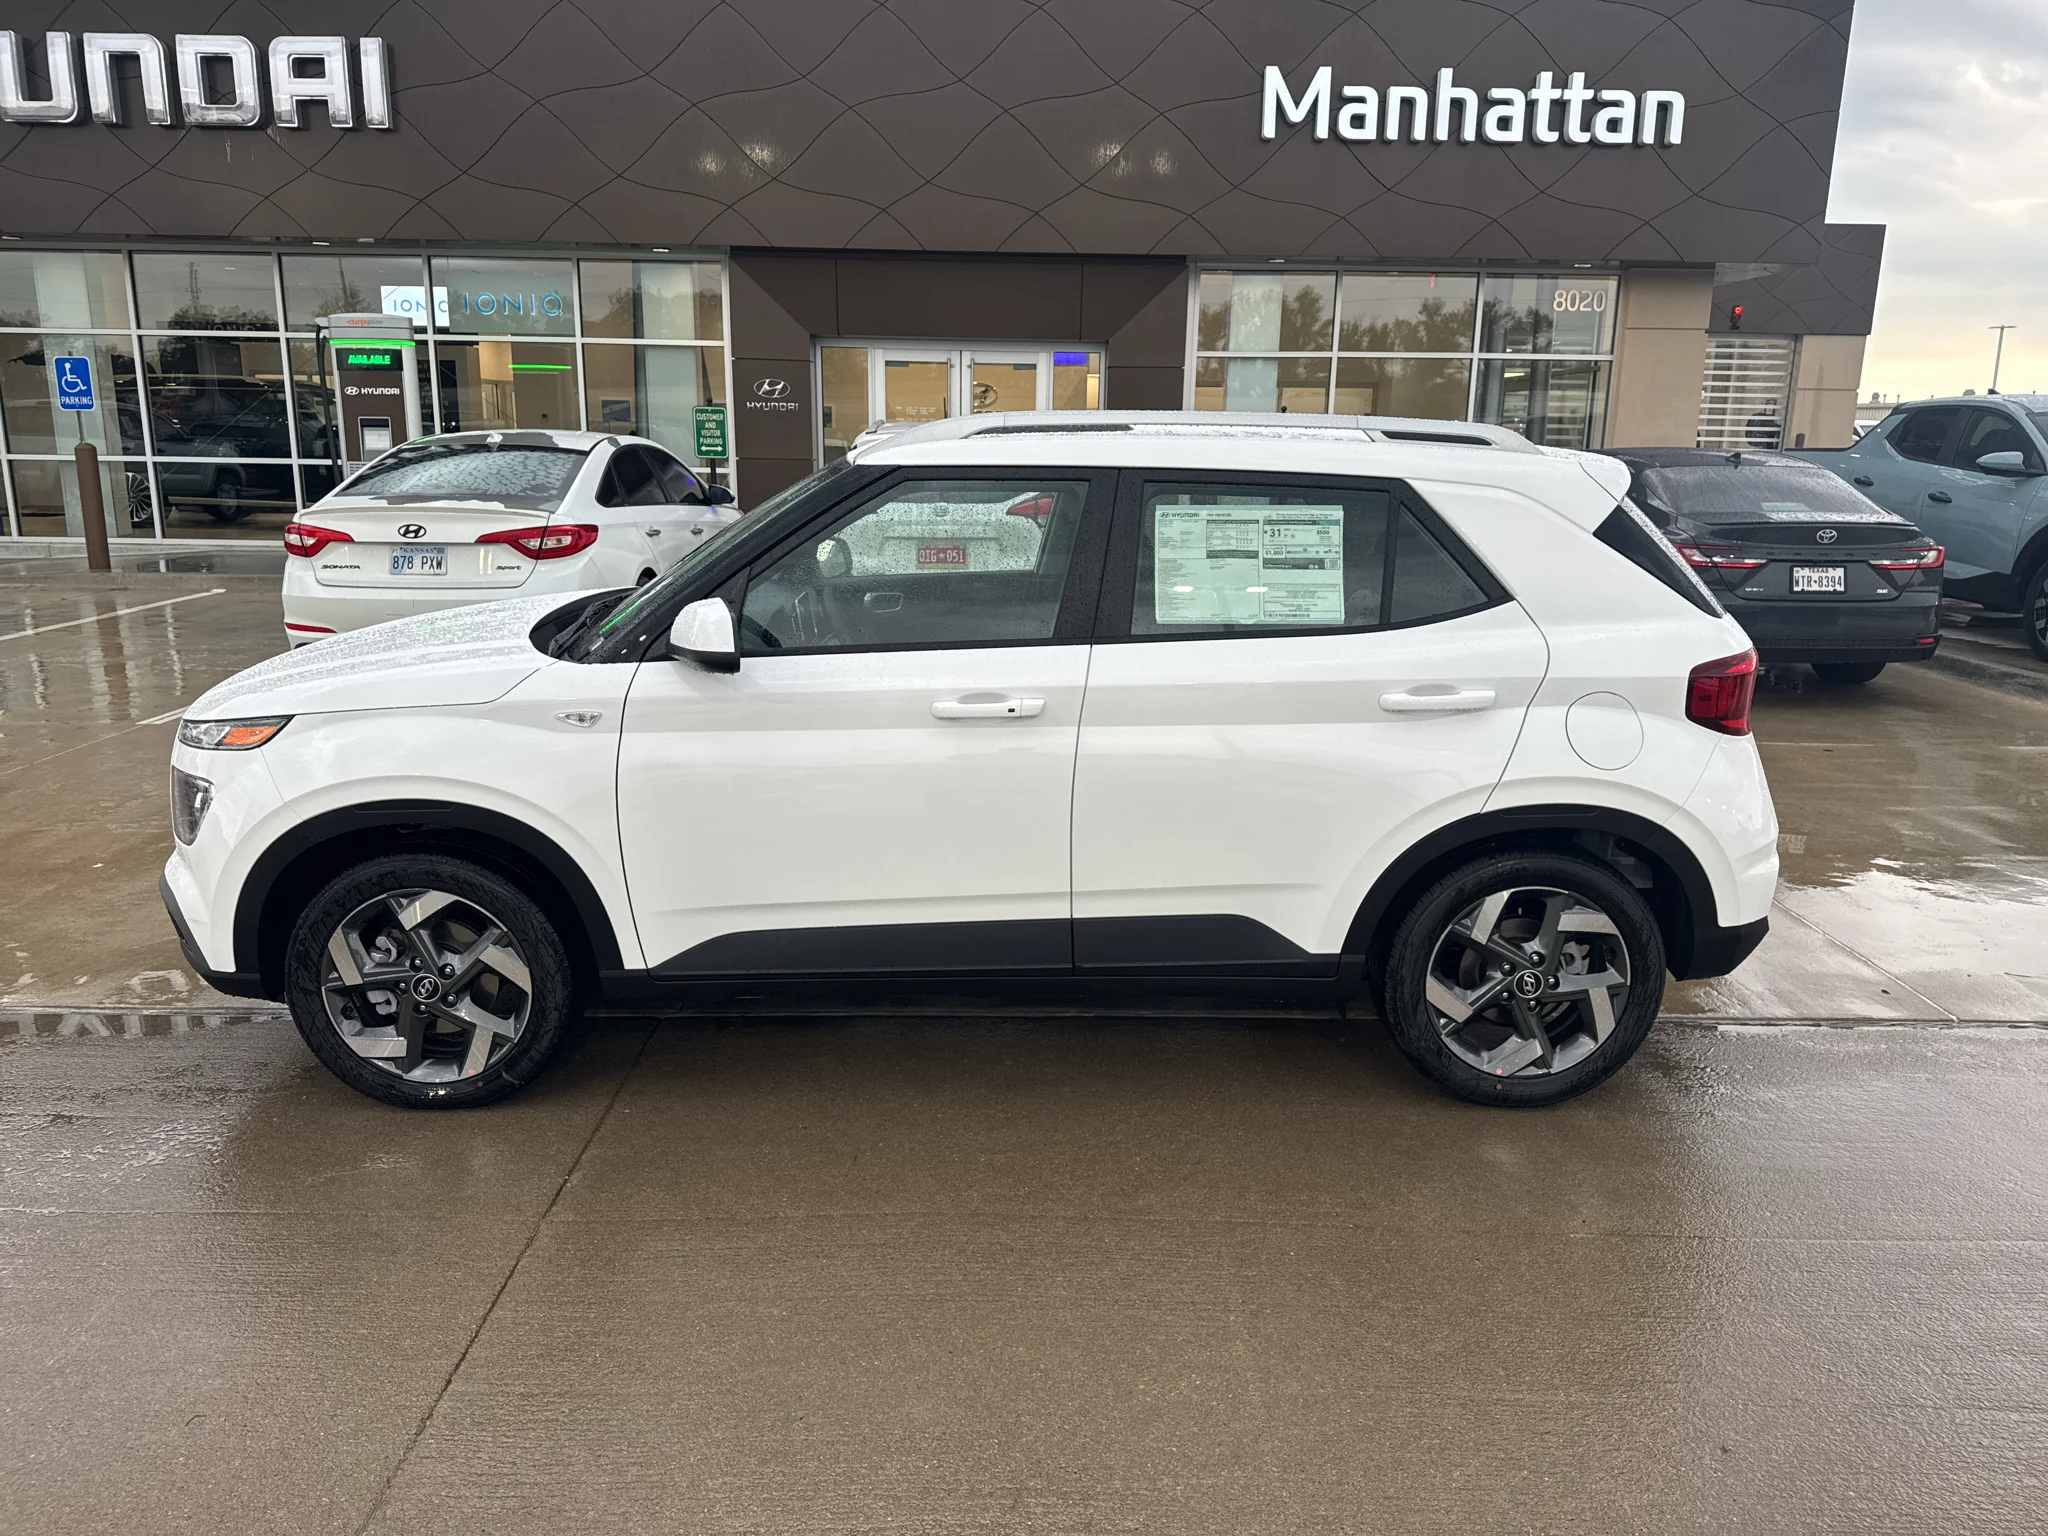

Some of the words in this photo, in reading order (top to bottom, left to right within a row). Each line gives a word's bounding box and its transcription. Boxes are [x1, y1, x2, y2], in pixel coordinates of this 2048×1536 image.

[1261, 65, 1686, 146] Manhattan
[463, 292, 563, 316] IONIQ
[1552, 289, 1606, 312] 8020
[347, 355, 391, 364] AVAILABLE
[361, 387, 400, 395] HYUNDAI
[60, 396, 93, 405] PARKING
[746, 401, 799, 411] HYUNDAI
[696, 413, 724, 421] CUSTOMER
[701, 429, 721, 437] VISITOR
[700, 437, 723, 445] PARKING
[1269, 528, 1281, 538] 31
[392, 555, 414, 570] 878
[421, 555, 443, 570] PXW
